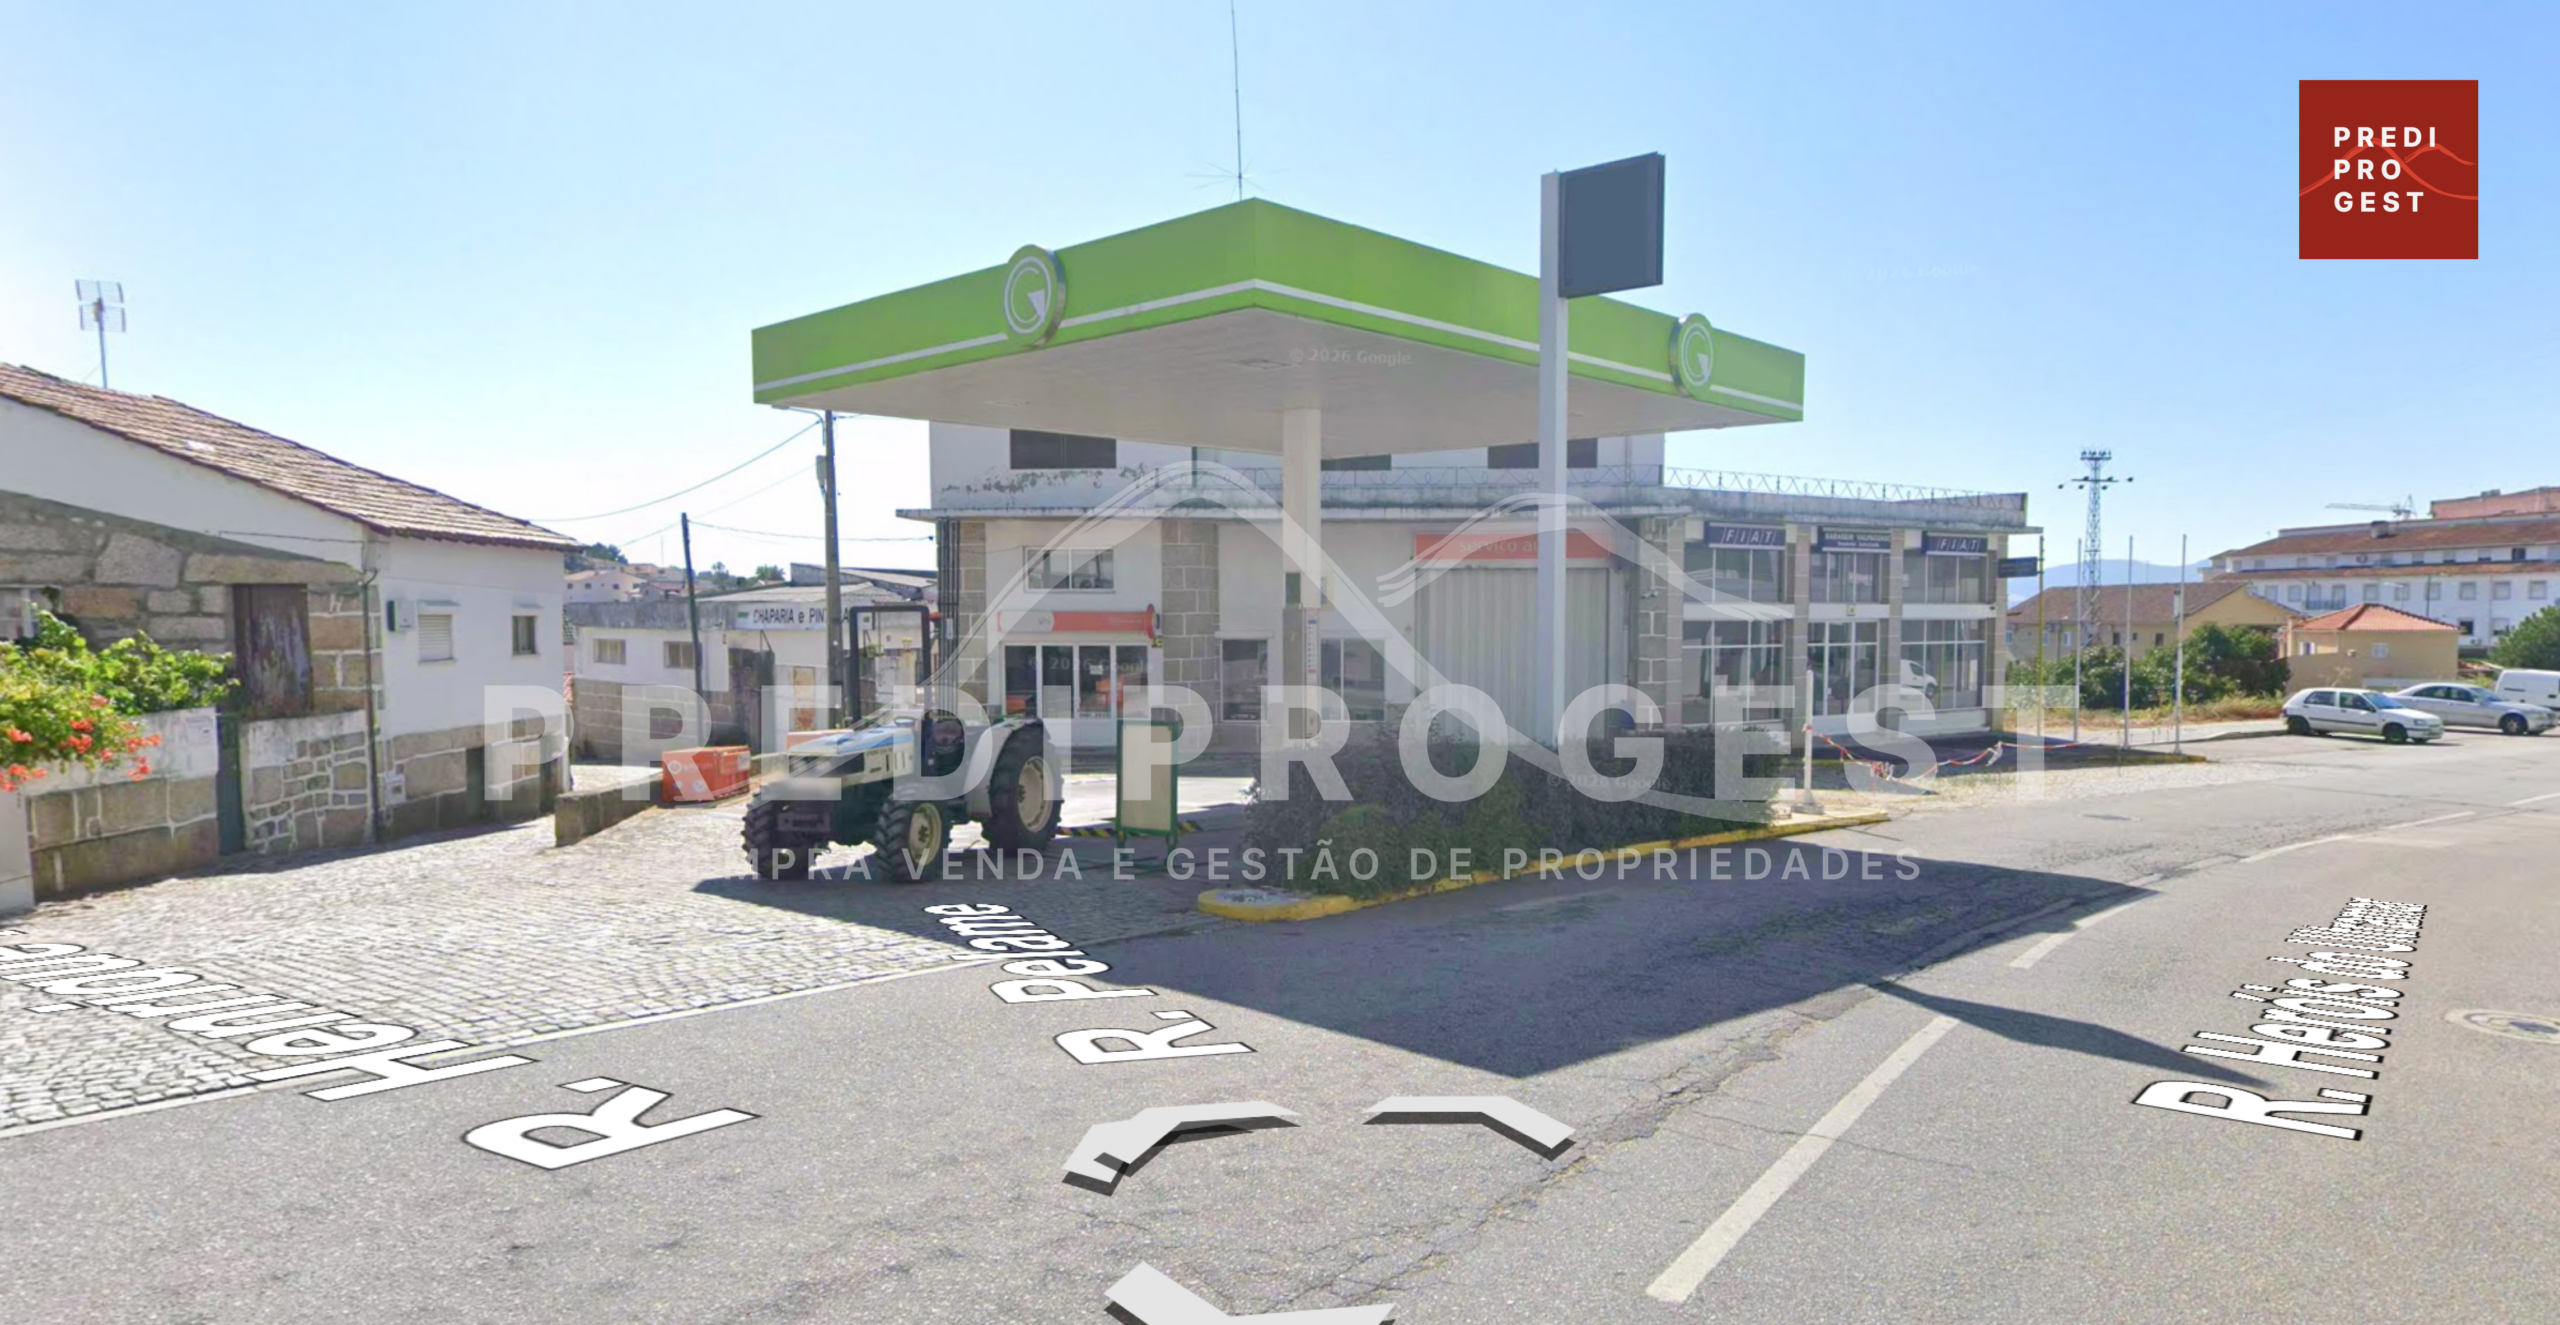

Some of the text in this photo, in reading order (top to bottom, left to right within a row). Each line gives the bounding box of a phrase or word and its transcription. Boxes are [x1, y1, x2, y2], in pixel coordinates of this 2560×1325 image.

[1726, 529, 1773, 543] FIAT
[1940, 538, 1979, 550] FIAT
[753, 607, 850, 624] CHAPARIA e PINA
